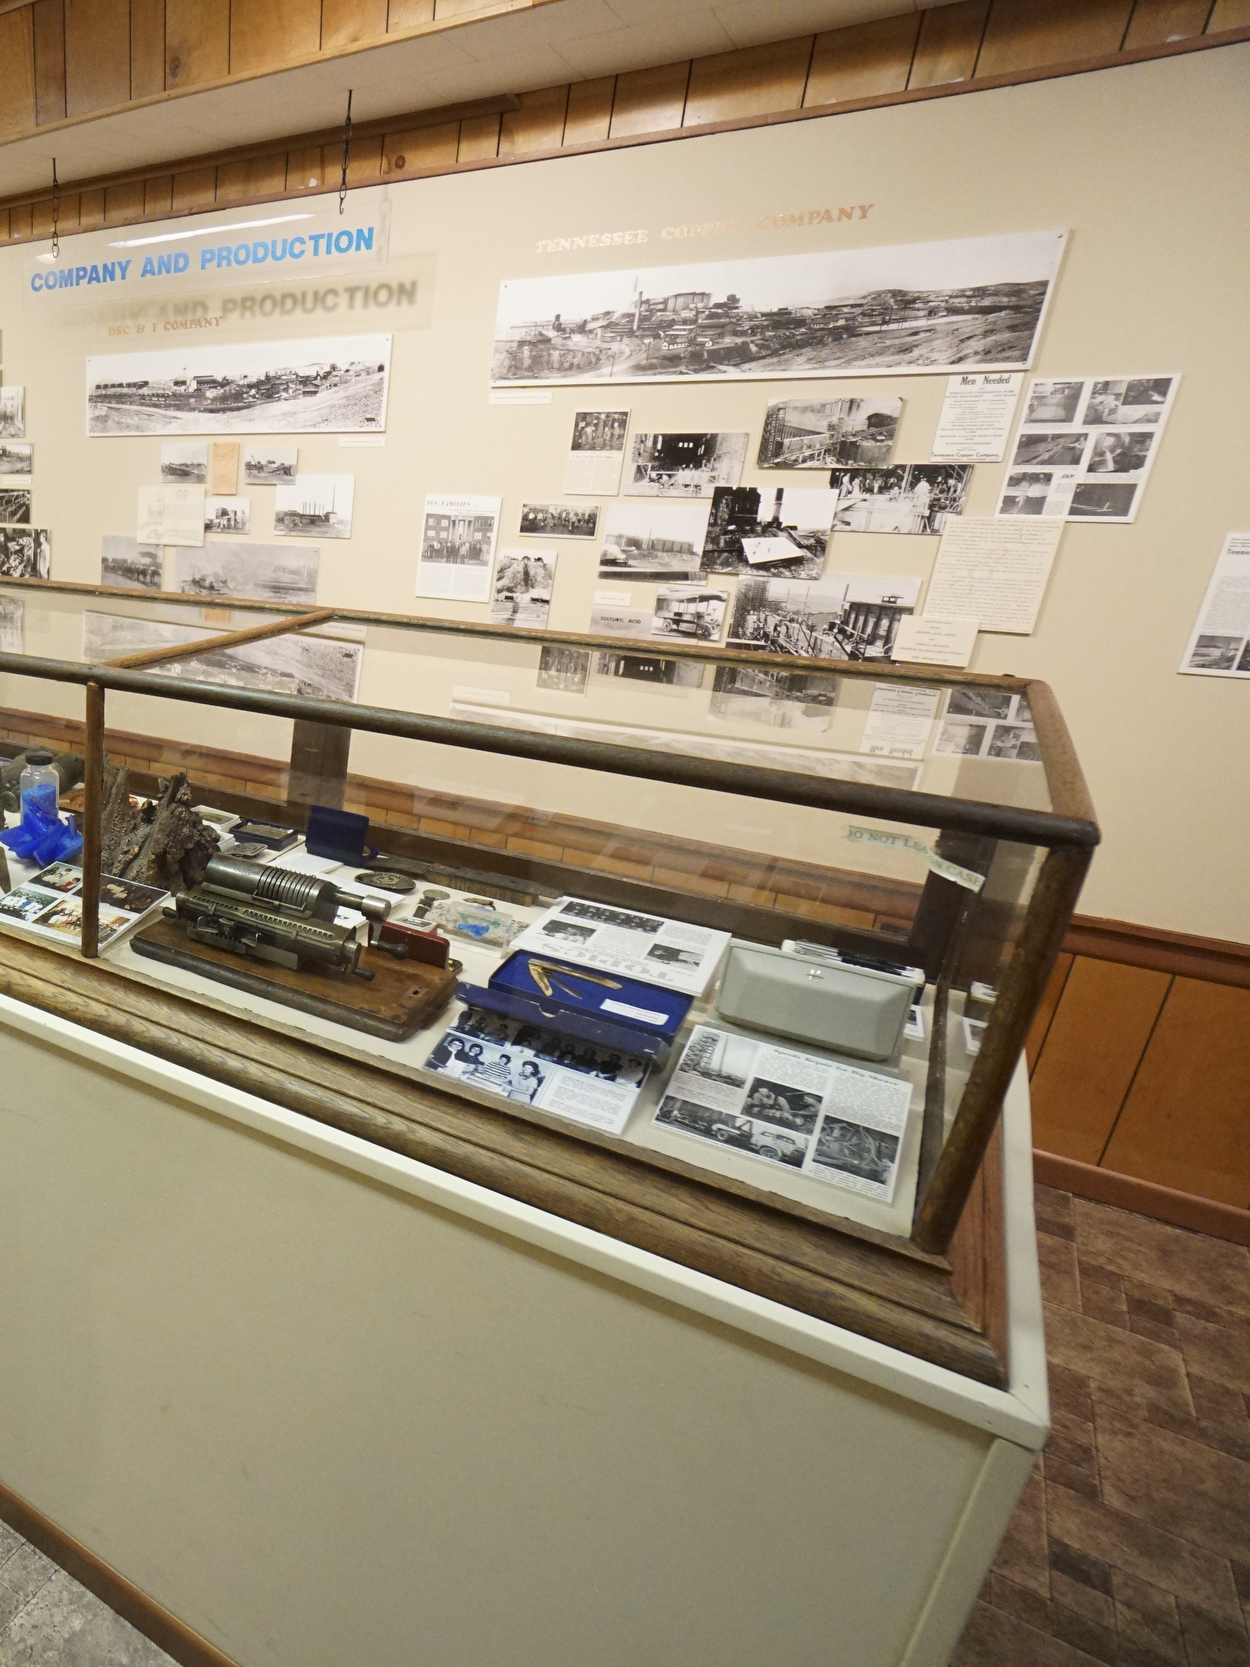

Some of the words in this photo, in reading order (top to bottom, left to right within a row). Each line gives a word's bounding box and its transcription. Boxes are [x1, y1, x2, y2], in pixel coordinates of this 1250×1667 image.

[535, 229, 649, 254] TENNESSEE
[756, 203, 876, 230] COMPANY
[30, 259, 132, 293] COMPANY
[140, 251, 190, 279] AND
[200, 226, 376, 271] PRODUCTION
[108, 325, 130, 337] DSC
[136, 324, 146, 334] &
[163, 316, 223, 332] COMPANY
[960, 375, 977, 386] Men
[982, 374, 1012, 386] Needed
[866, 831, 901, 846] NOT
[946, 864, 982, 887] CASE
[541, 942, 675, 983] TOPICS
